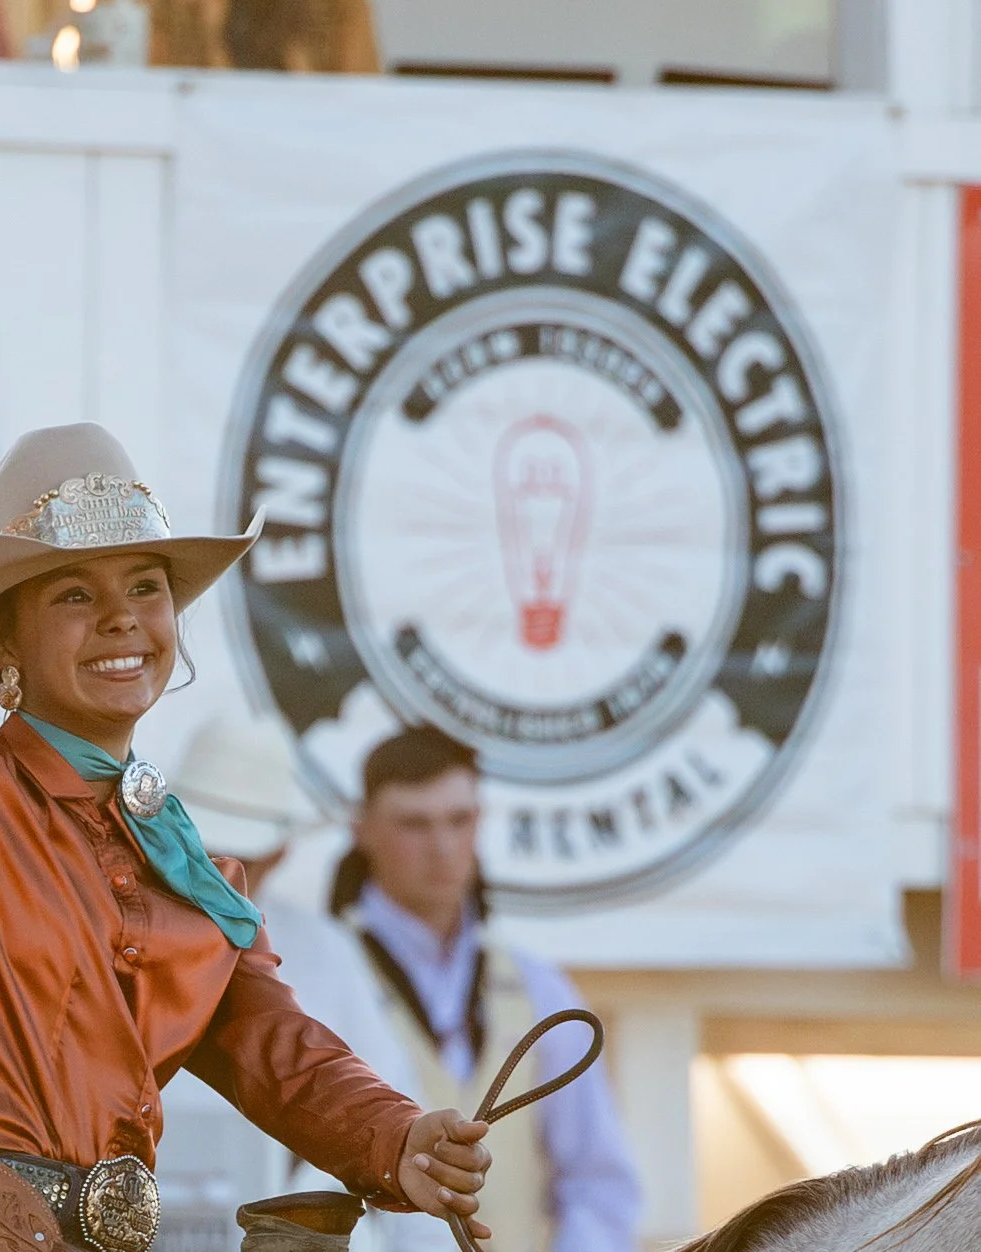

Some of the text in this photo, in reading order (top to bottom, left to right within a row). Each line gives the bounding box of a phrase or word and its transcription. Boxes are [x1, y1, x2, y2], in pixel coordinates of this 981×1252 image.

[249, 188, 828, 600] ENTERPRISE ELECTRIC
[79, 498, 123, 510] CHIEF
[118, 505, 146, 519] DAYS
[68, 520, 141, 536] PRINCESS
[508, 745, 730, 860] RENTAL
